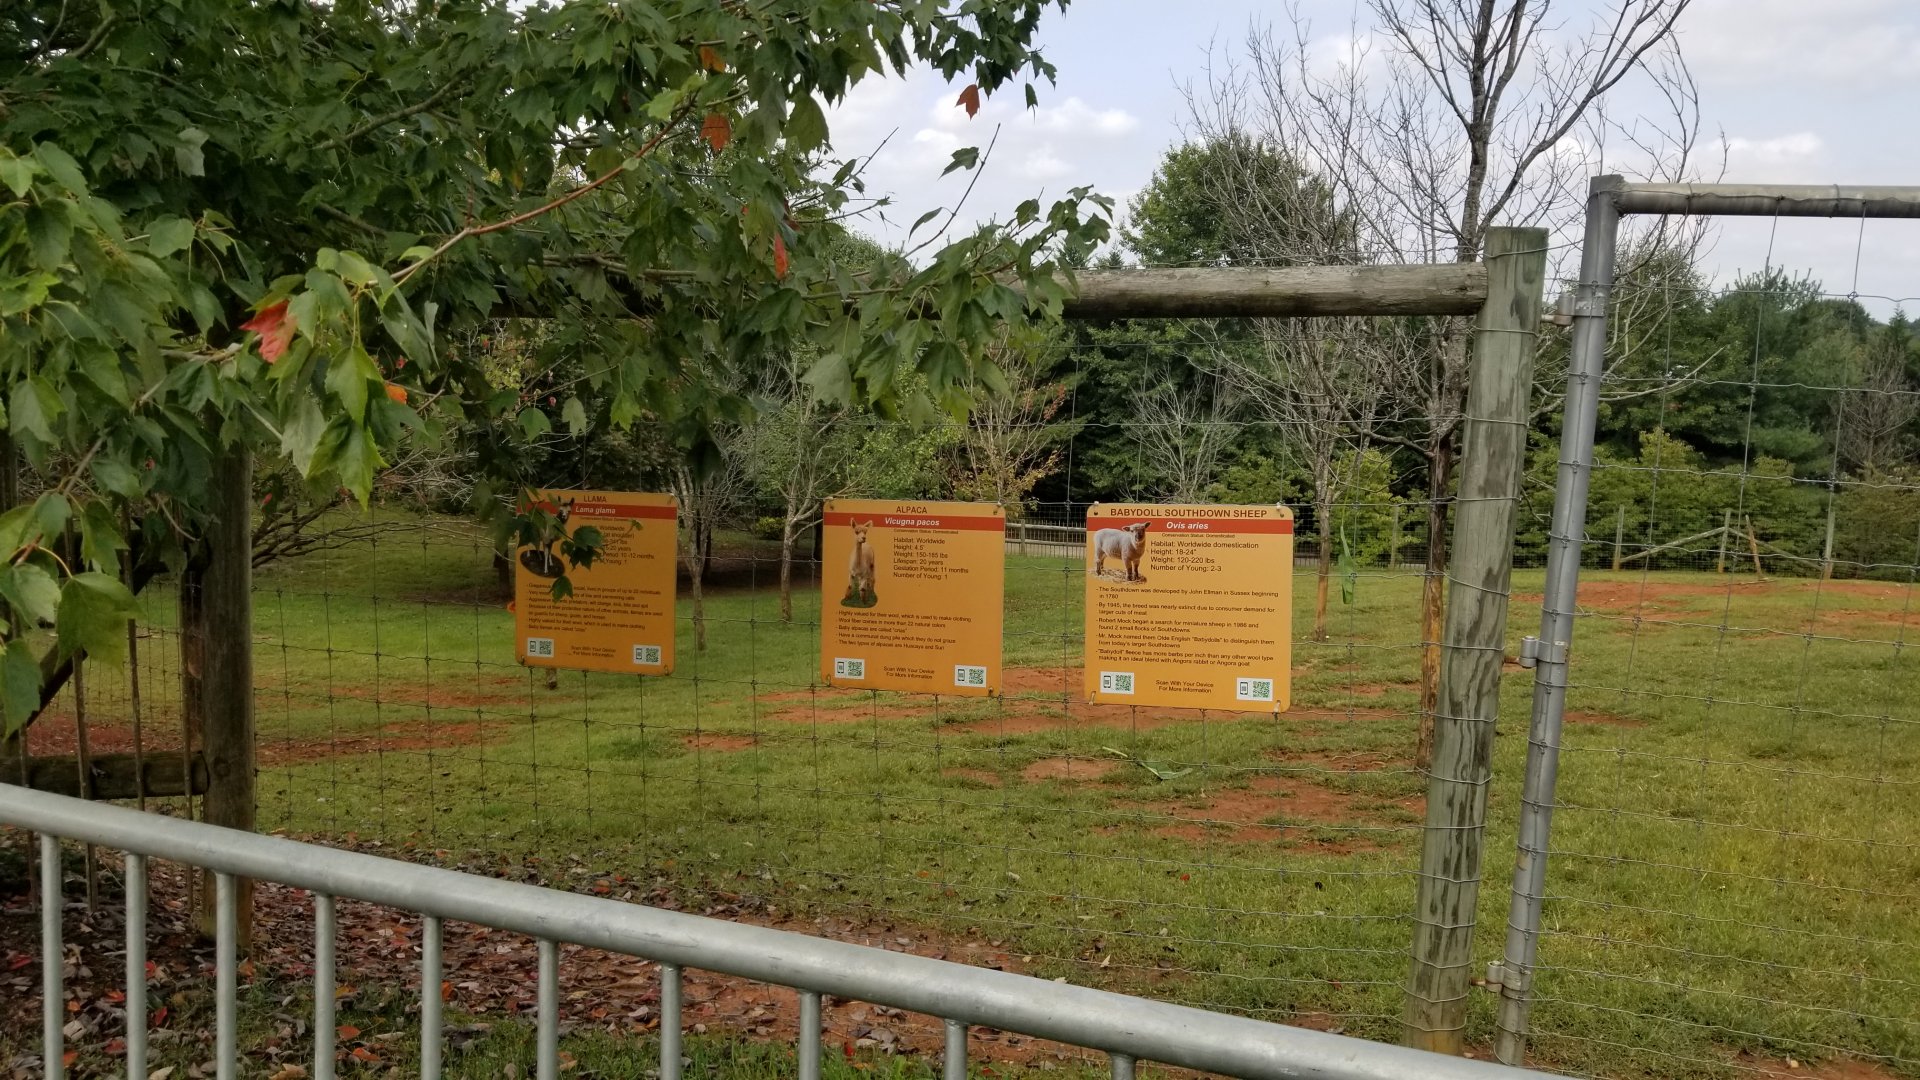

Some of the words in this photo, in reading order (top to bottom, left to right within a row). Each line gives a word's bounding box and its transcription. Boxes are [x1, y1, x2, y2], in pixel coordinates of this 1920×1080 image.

[596, 507, 616, 515] glama
[896, 506, 928, 514] ALPACA
[885, 518, 914, 526] Vicugna
